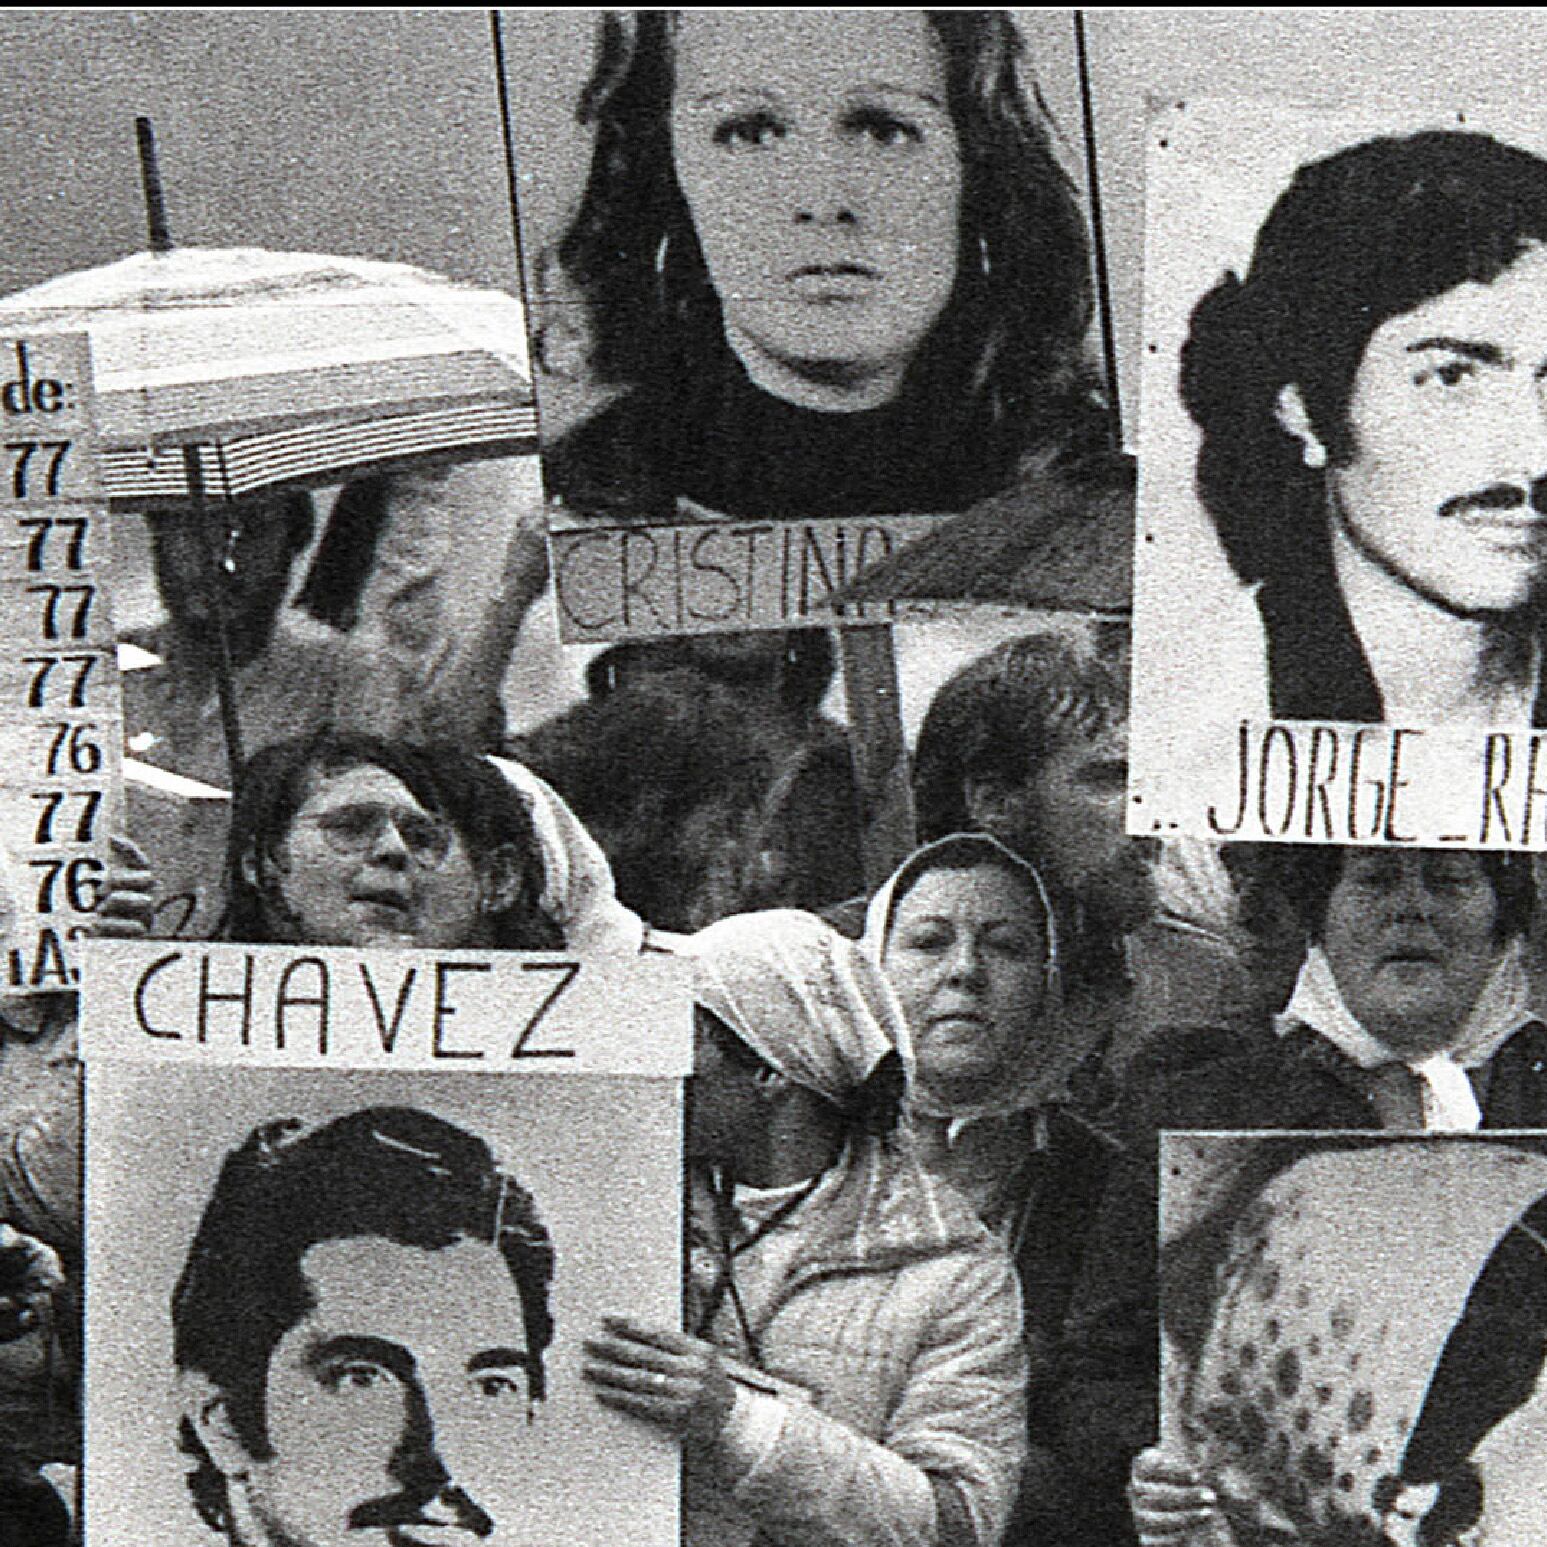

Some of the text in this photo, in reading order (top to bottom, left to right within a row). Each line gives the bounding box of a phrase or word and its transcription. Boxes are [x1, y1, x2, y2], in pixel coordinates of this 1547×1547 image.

[2, 340, 74, 414] de:
[4, 441, 72, 497] 77
[19, 516, 88, 569] 77
[25, 585, 96, 640] 77
[21, 655, 98, 708] 77
[37, 722, 102, 774] 76
[1206, 719, 1424, 842] JORGE
[29, 791, 103, 845] 77
[28, 856, 106, 914] 76
[134, 951, 582, 1059] CHAVEZ
